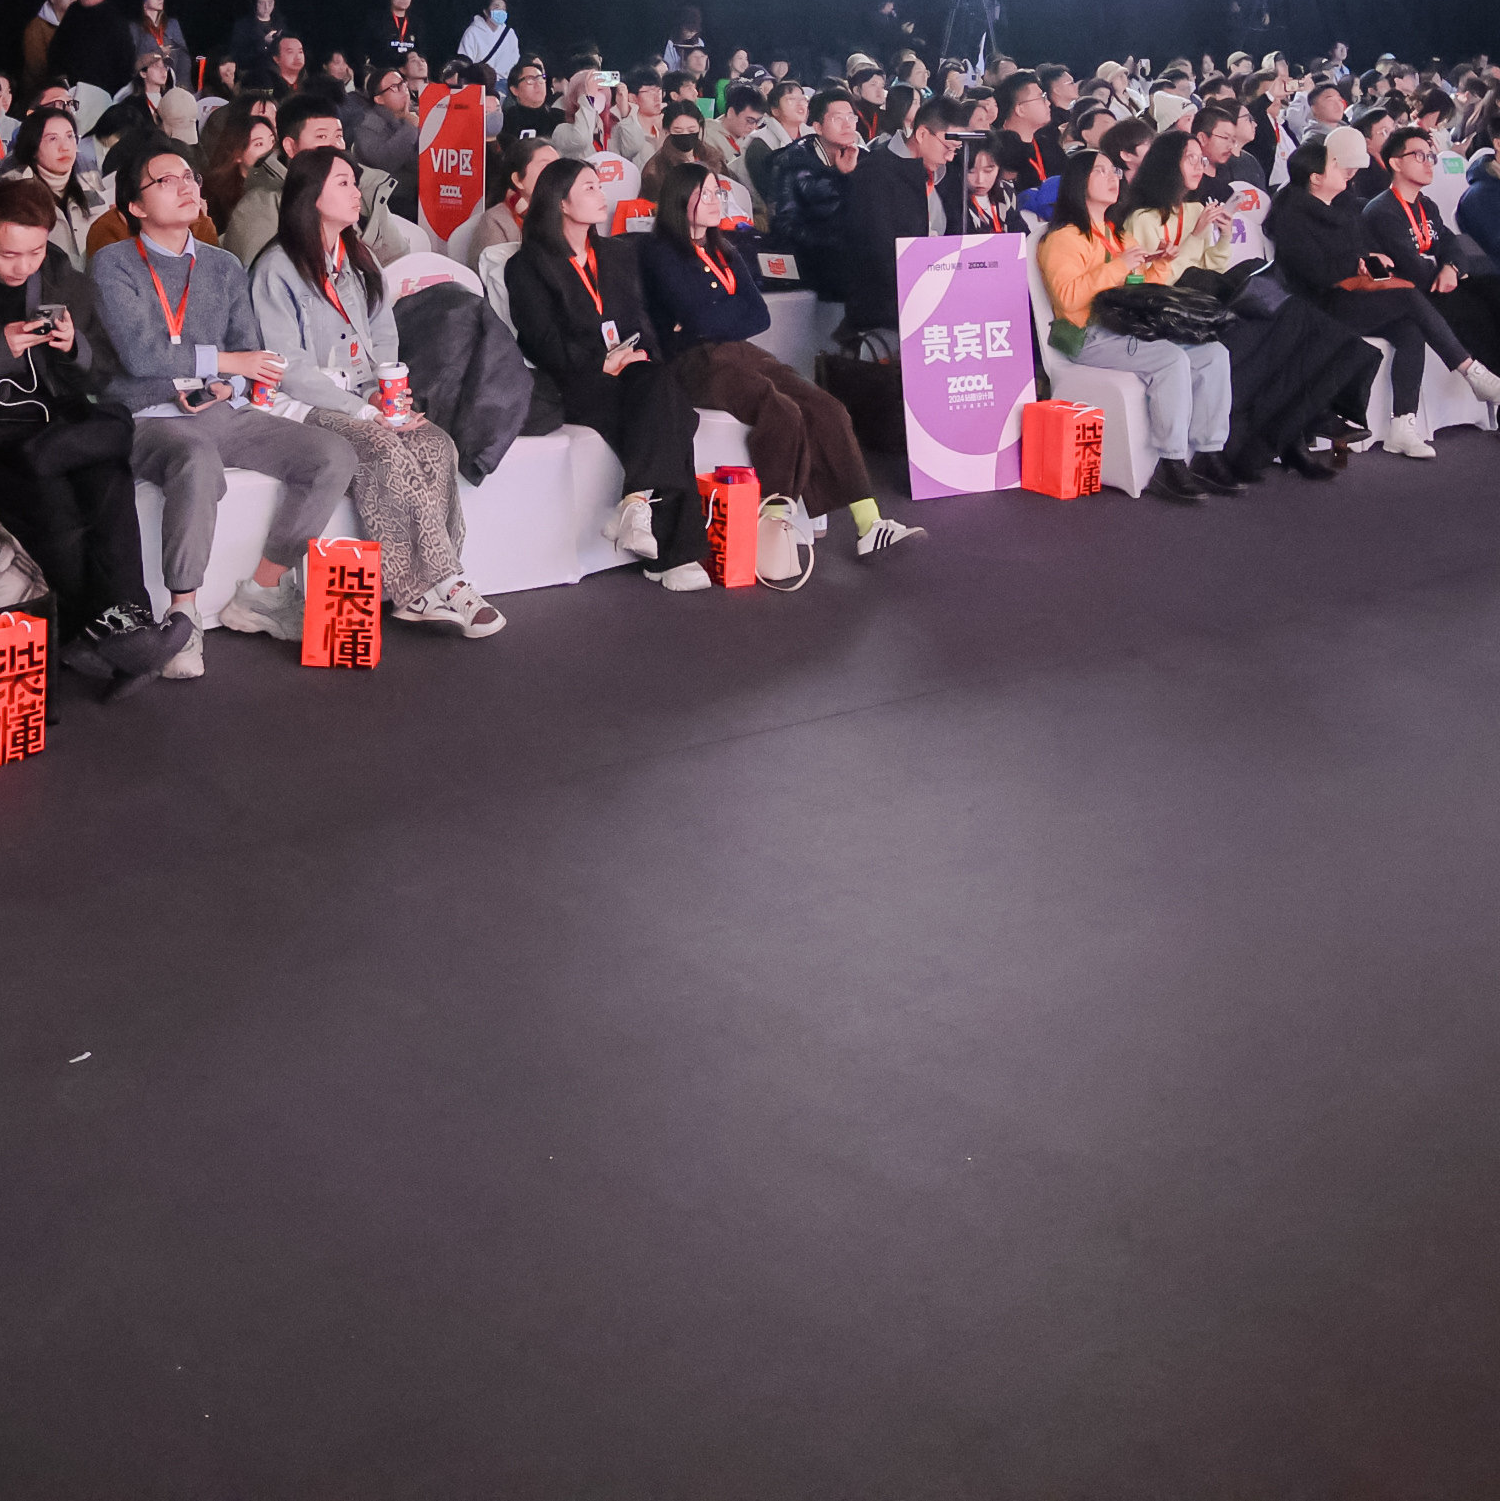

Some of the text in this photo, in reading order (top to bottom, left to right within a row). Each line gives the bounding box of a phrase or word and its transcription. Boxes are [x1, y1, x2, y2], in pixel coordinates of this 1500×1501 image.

[430, 147, 473, 176] VIP区
[921, 320, 1013, 366] 贵宾区
[947, 373, 993, 393] ZCOOL
